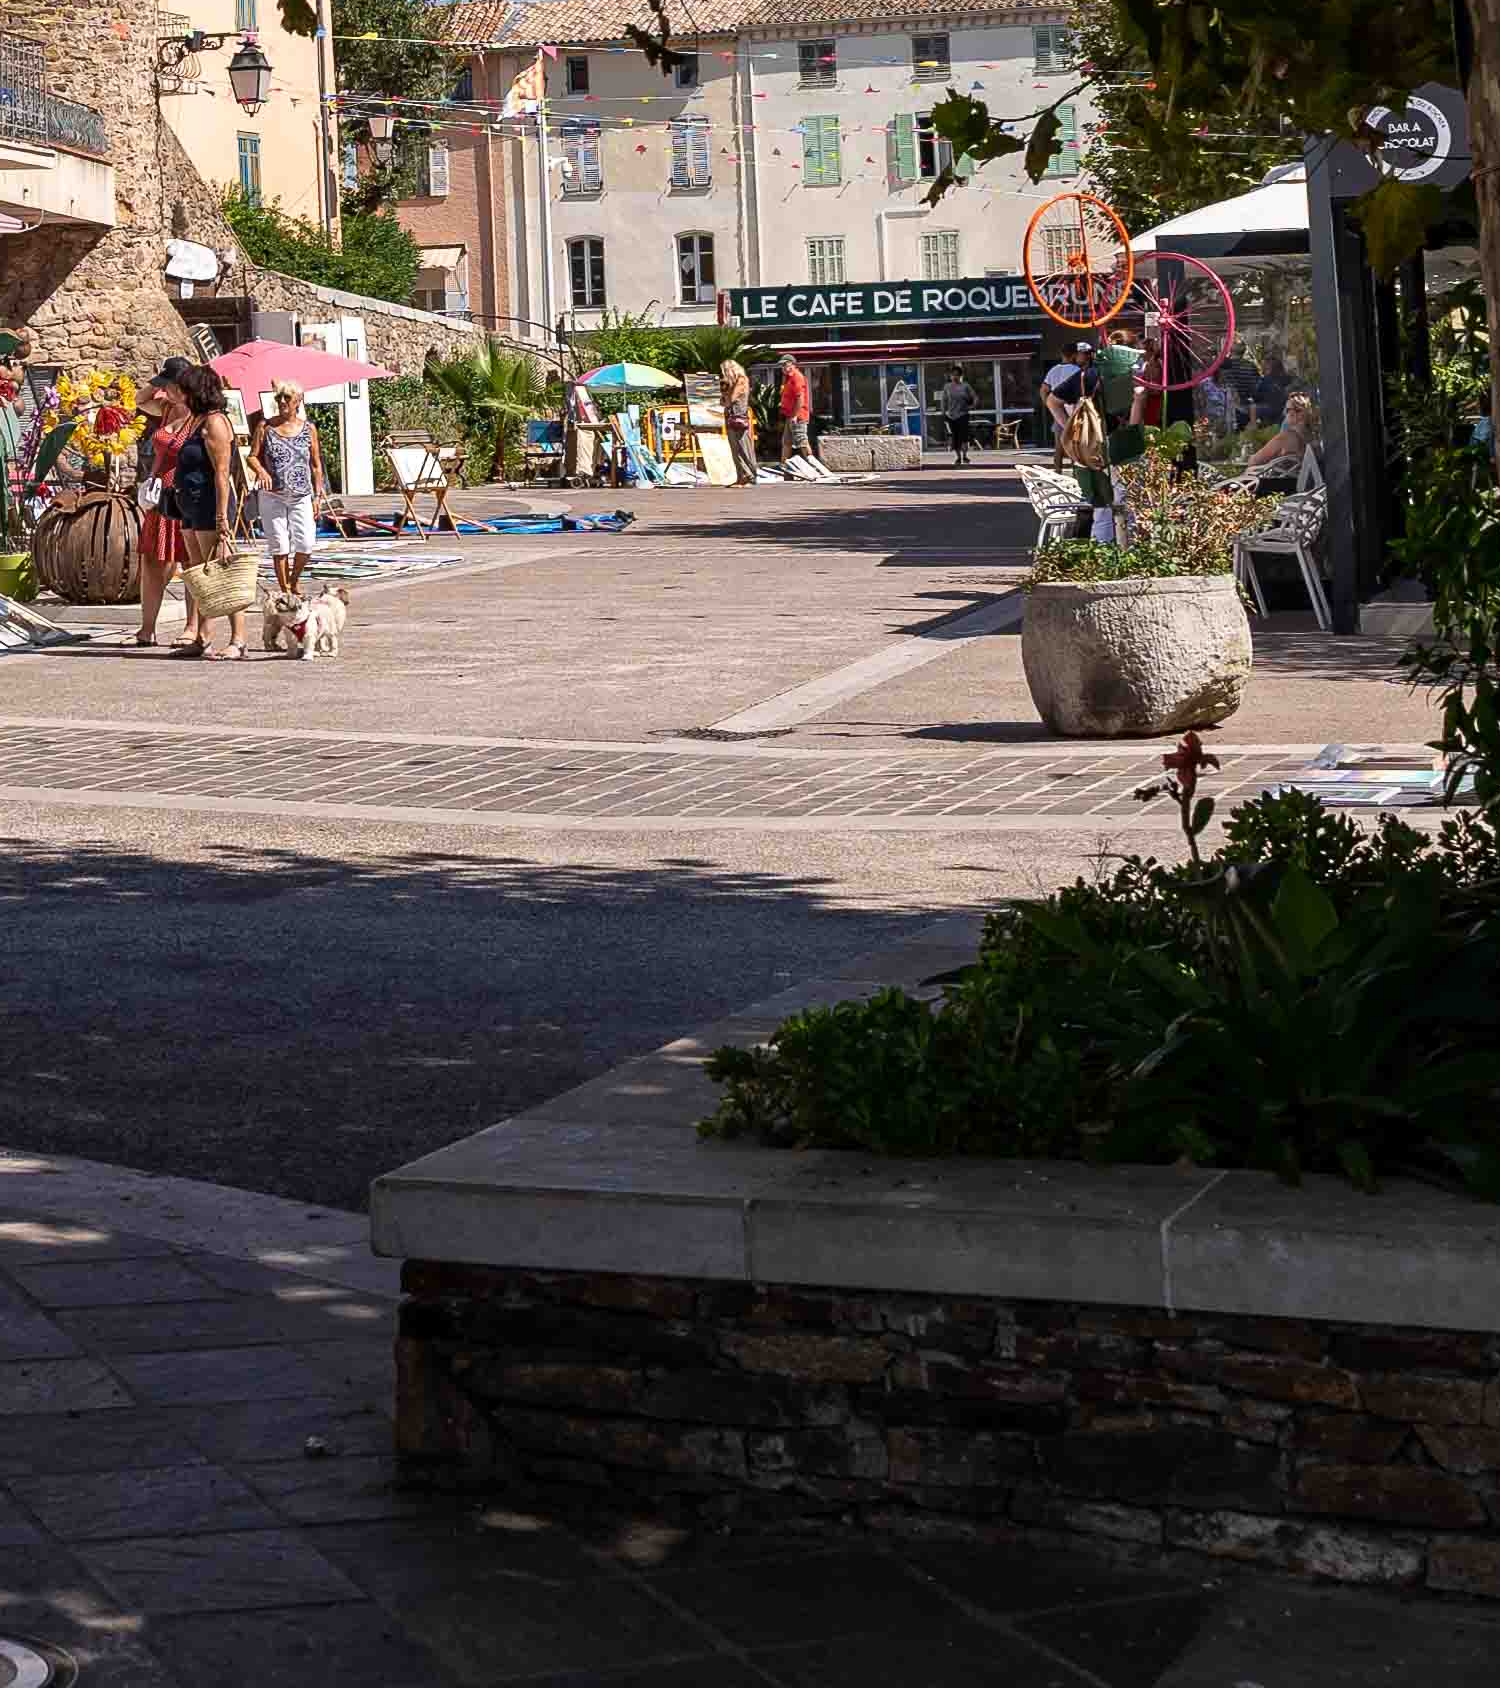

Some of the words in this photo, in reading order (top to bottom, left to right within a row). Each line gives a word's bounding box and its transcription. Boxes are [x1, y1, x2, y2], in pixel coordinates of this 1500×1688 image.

[1388, 122, 1410, 133] BAR
[1378, 136, 1436, 150] HOCOLAT
[742, 295, 778, 319] LE
[787, 291, 865, 318] CAFE
[873, 289, 913, 314] DE
